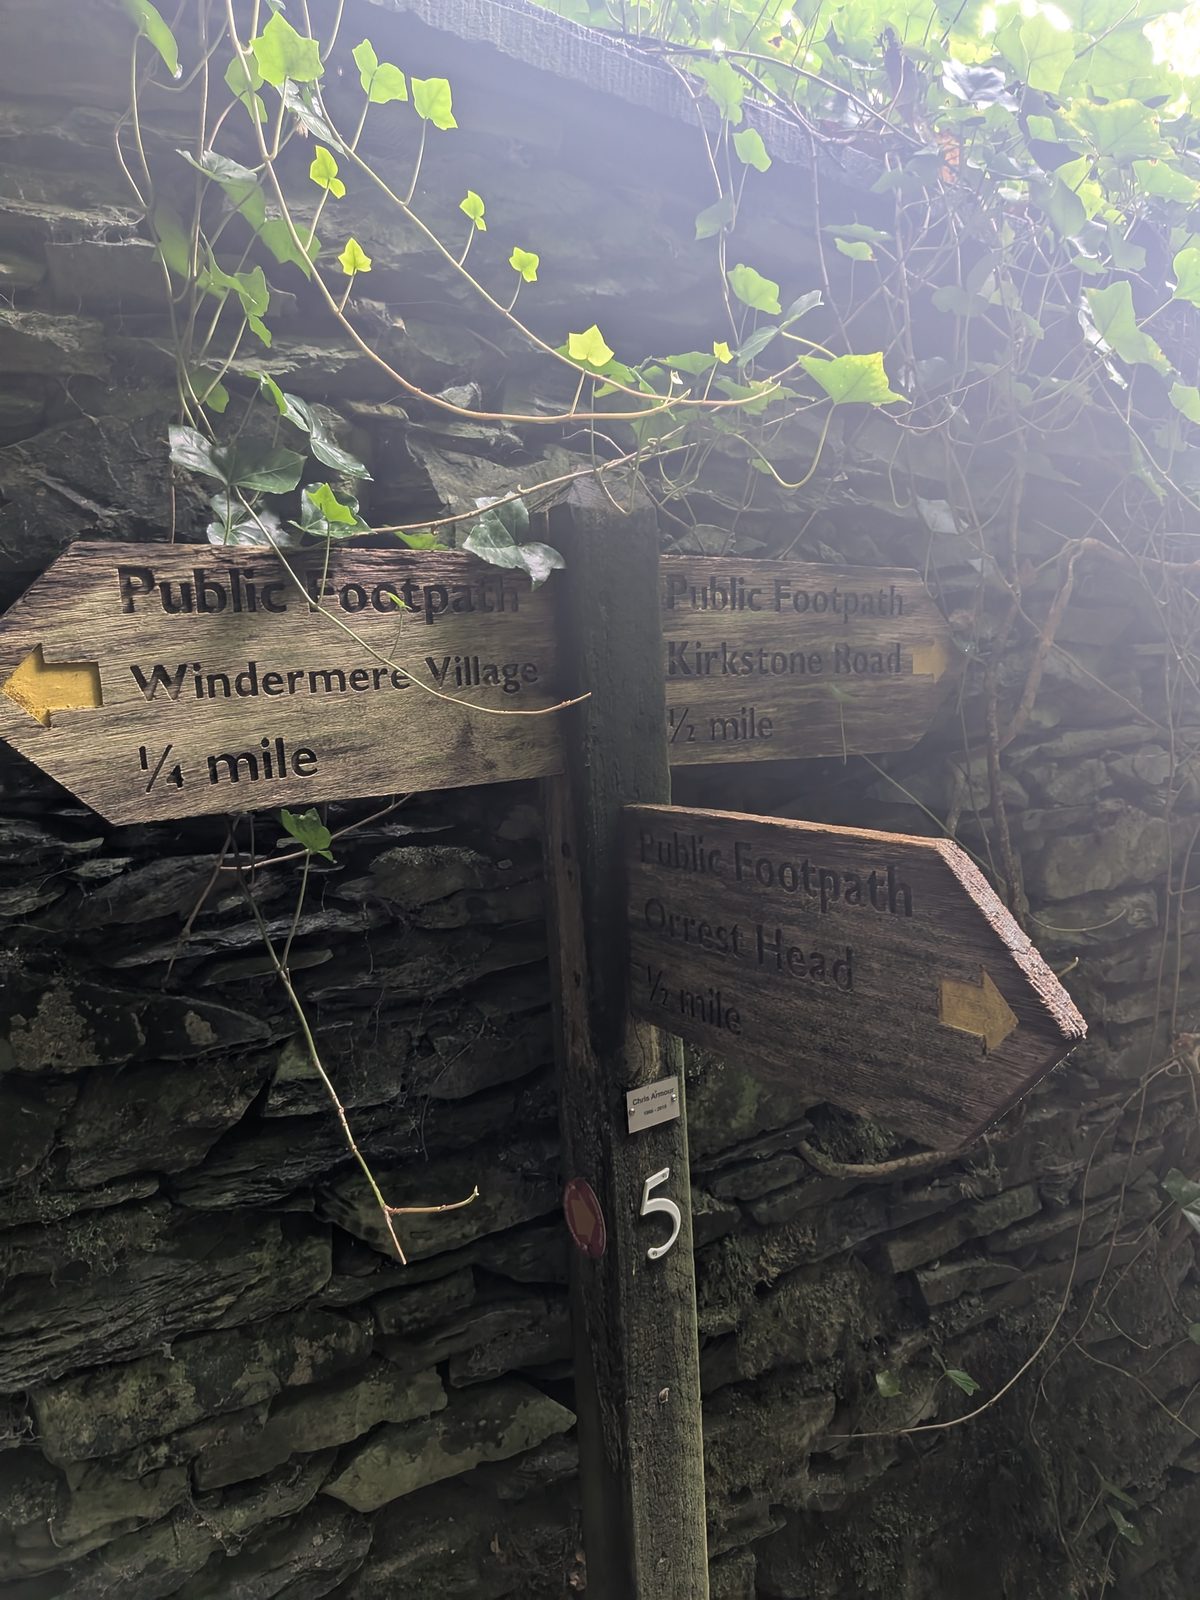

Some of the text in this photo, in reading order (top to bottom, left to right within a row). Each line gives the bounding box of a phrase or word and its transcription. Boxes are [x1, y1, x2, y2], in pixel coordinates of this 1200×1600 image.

[117, 566, 520, 624] Public Footpath
[665, 574, 903, 623] Public Footpath
[130, 656, 537, 701] Windermere Village
[667, 640, 901, 675] Kirkstone Road
[710, 707, 774, 740] mile
[207, 737, 318, 785] mile
[640, 829, 913, 917] Public Footpath
[644, 897, 853, 993] Orrest Head
[680, 986, 742, 1036] mile
[632, 1096, 650, 1106] Chris
[640, 1167, 681, 1259] 5
